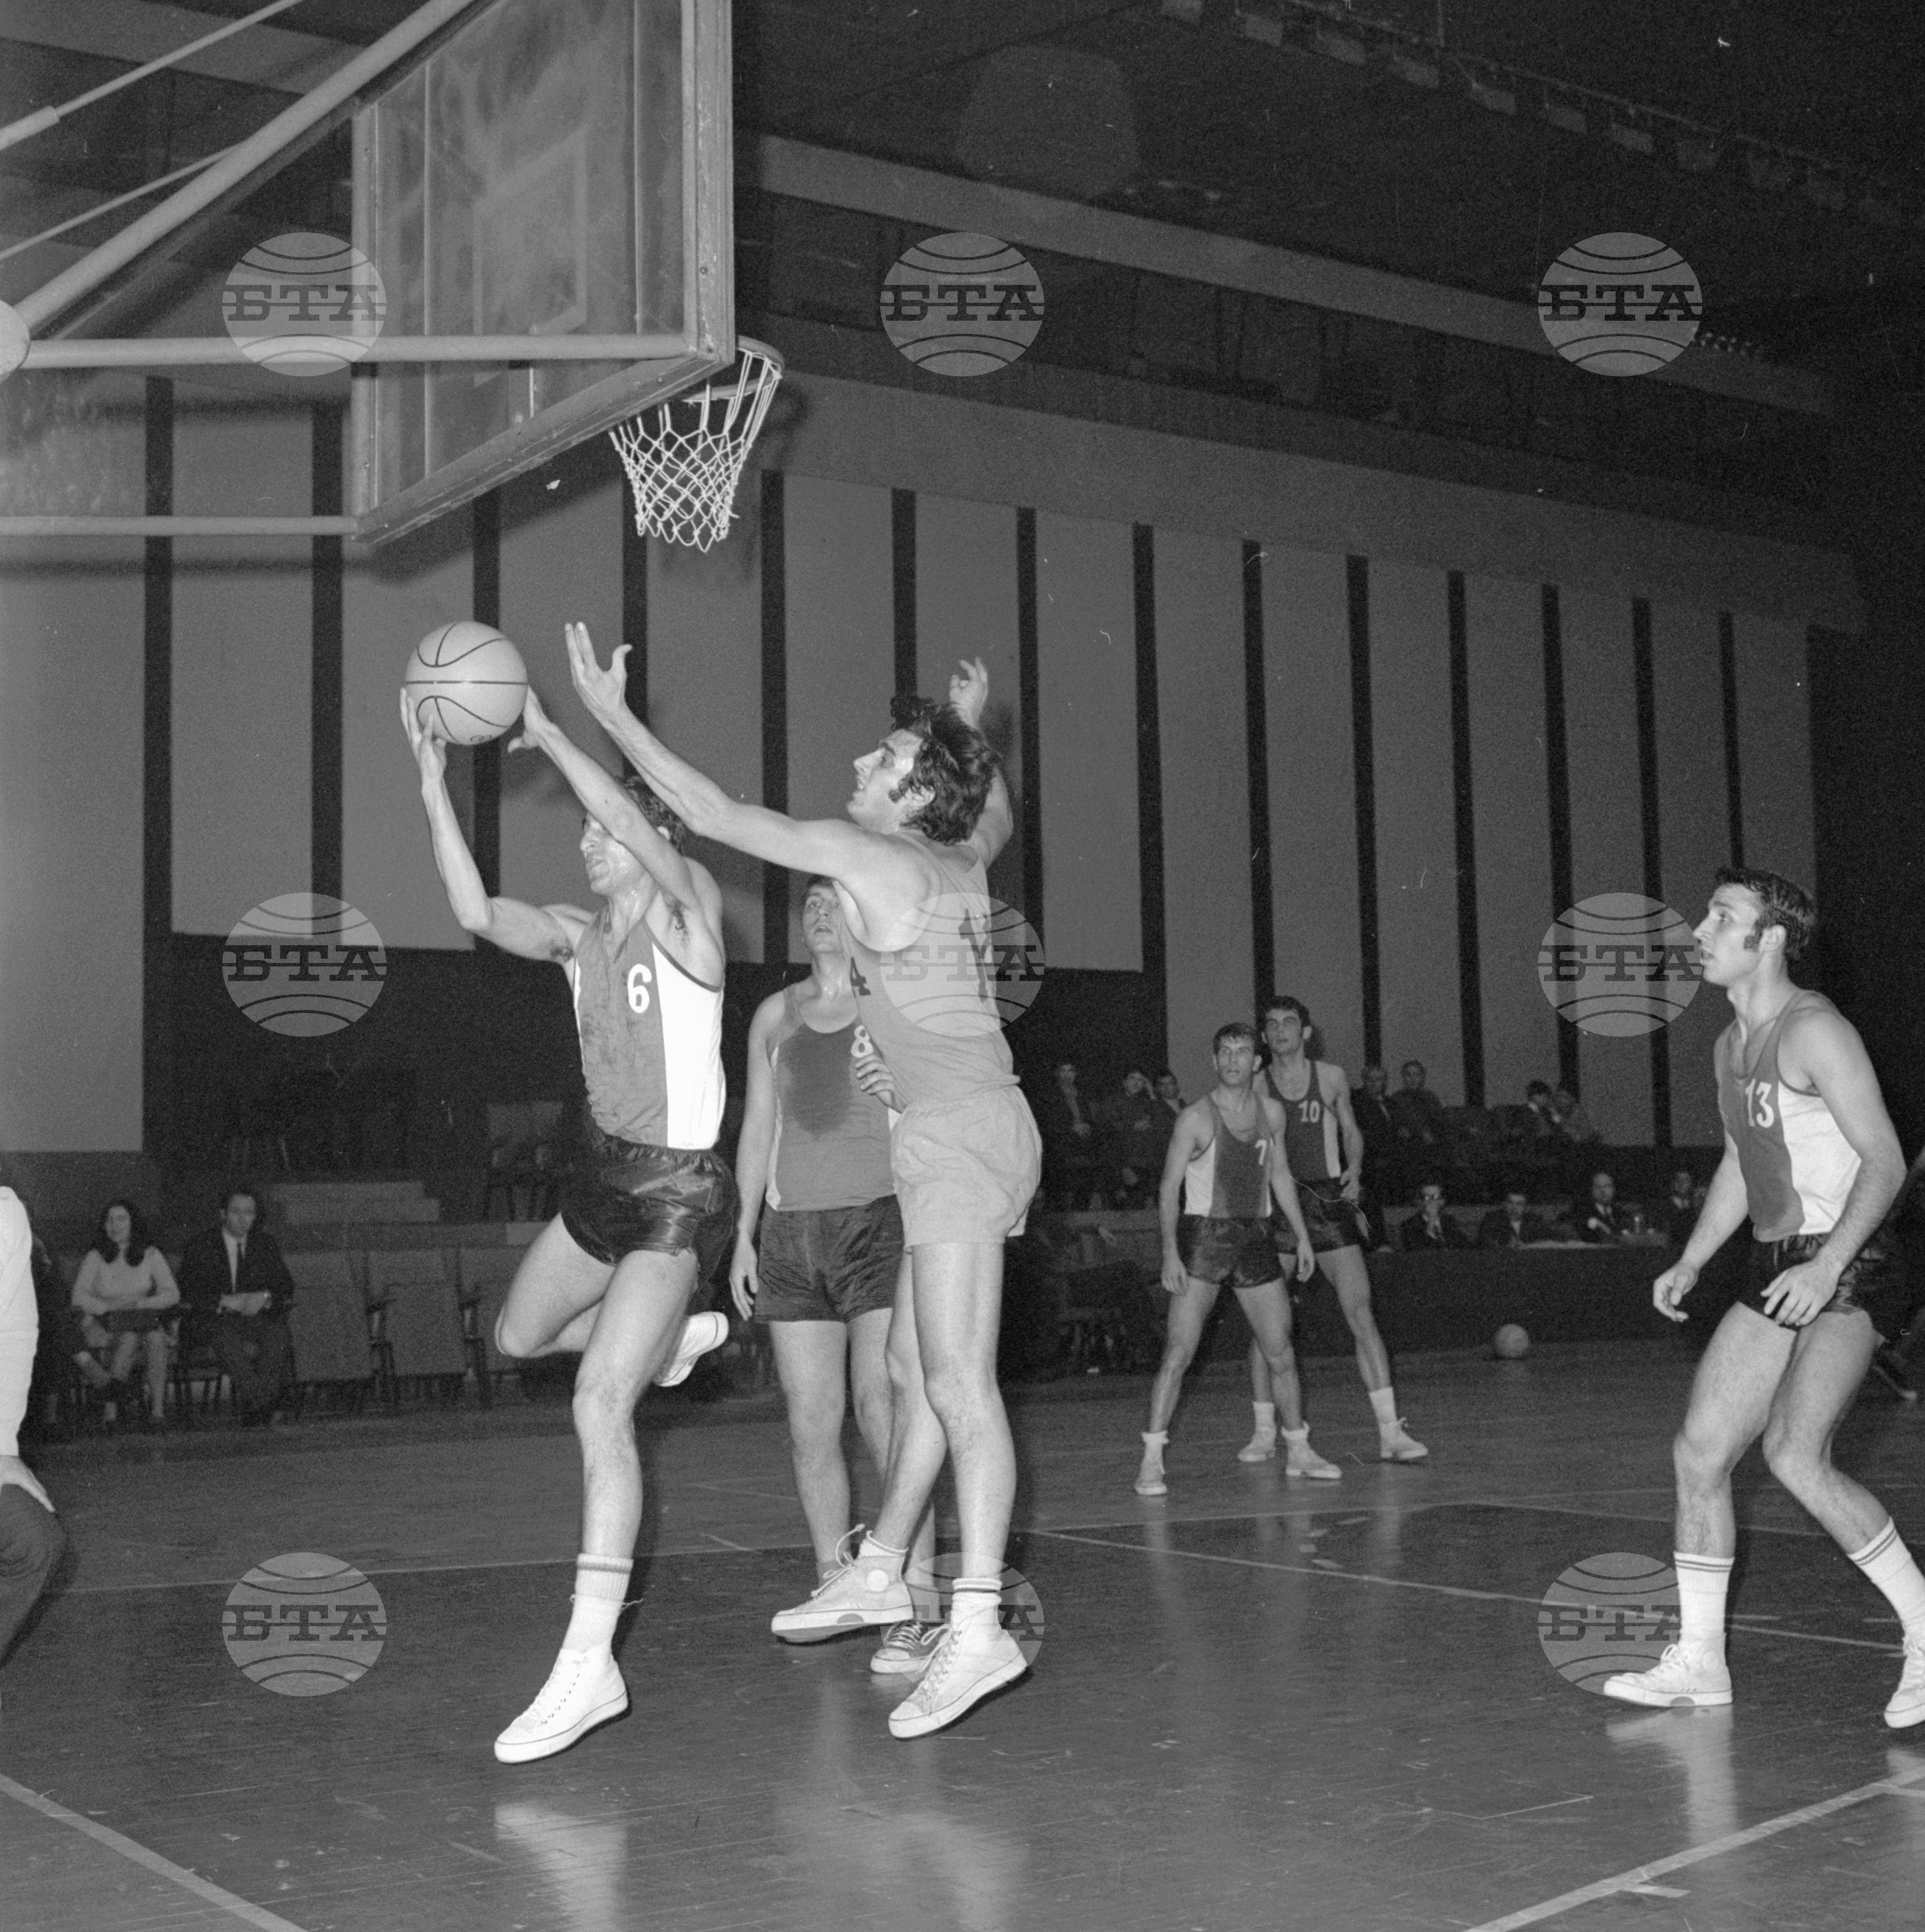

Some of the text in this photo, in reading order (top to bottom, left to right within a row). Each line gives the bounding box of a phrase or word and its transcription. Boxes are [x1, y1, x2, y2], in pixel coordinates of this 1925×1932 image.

[627, 963, 652, 1013] 6
[851, 1024, 873, 1058] 8
[1299, 1100, 1320, 1123] 10
[1745, 1078, 1774, 1128] 13
